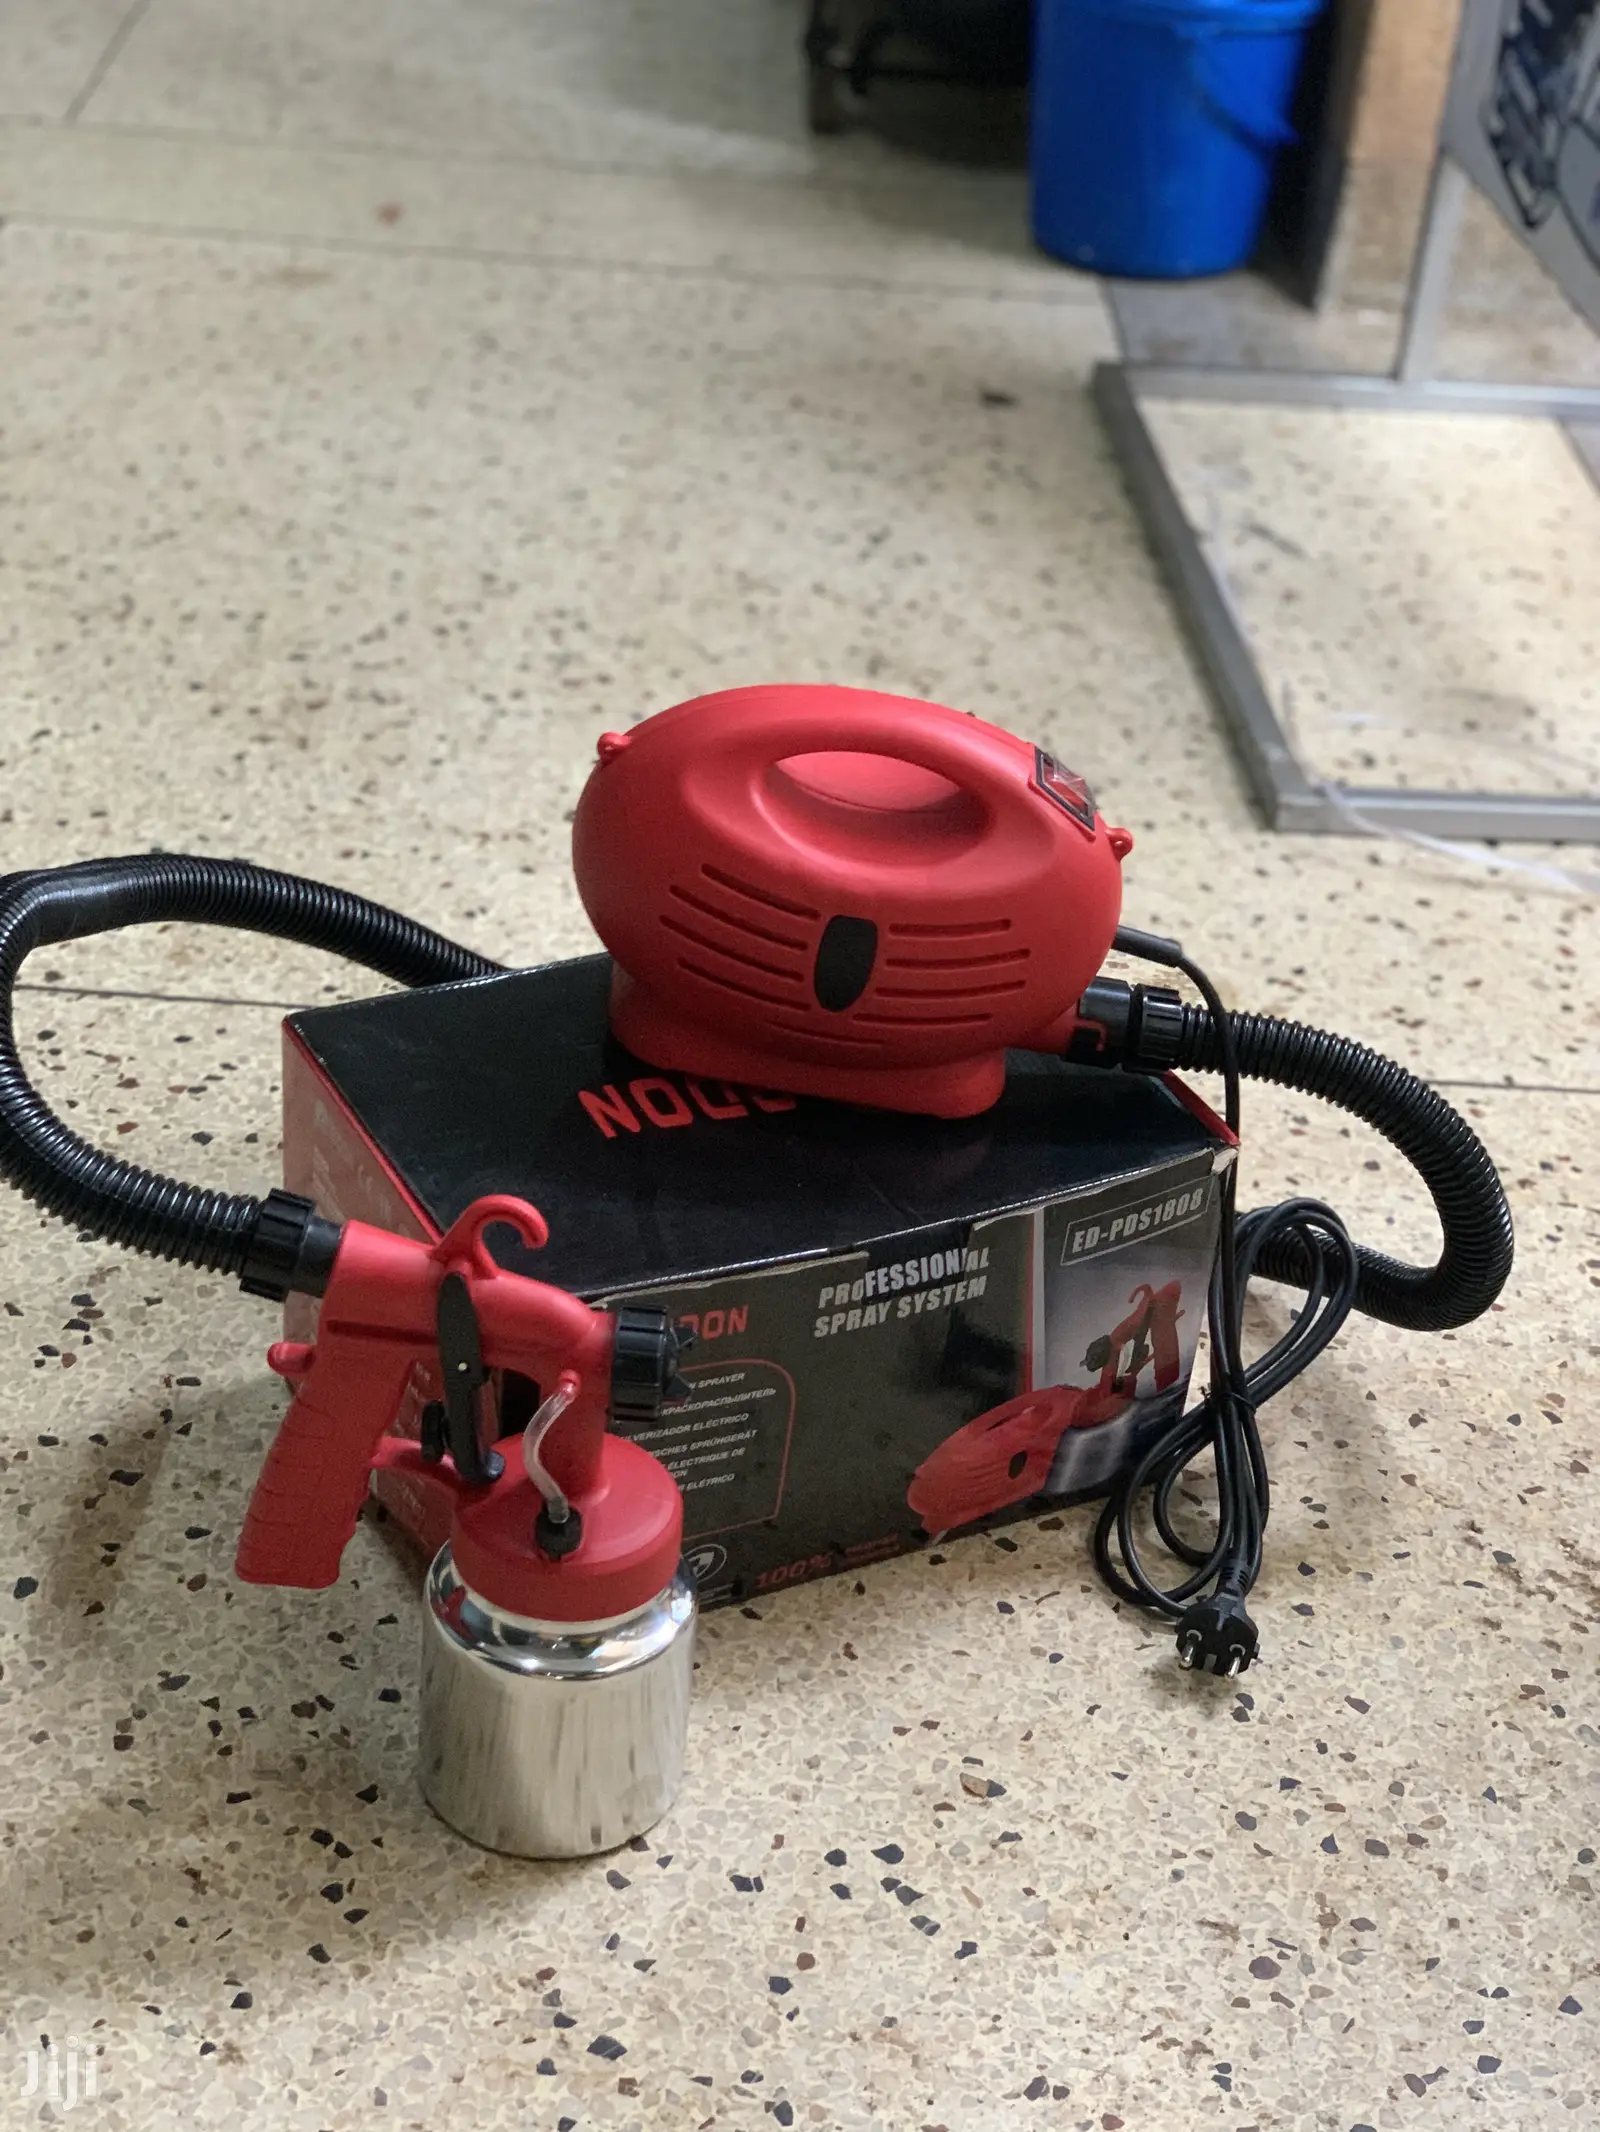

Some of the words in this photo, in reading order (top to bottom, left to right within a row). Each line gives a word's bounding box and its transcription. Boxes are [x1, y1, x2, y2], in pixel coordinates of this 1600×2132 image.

[1071, 1187, 1204, 1254] ED-PDS1808
[814, 1300, 891, 1338] SPRAY
[897, 1275, 988, 1318] SYSTEM
[698, 1371, 746, 1389] SPRAYER
[756, 1552, 833, 1589] 100%
